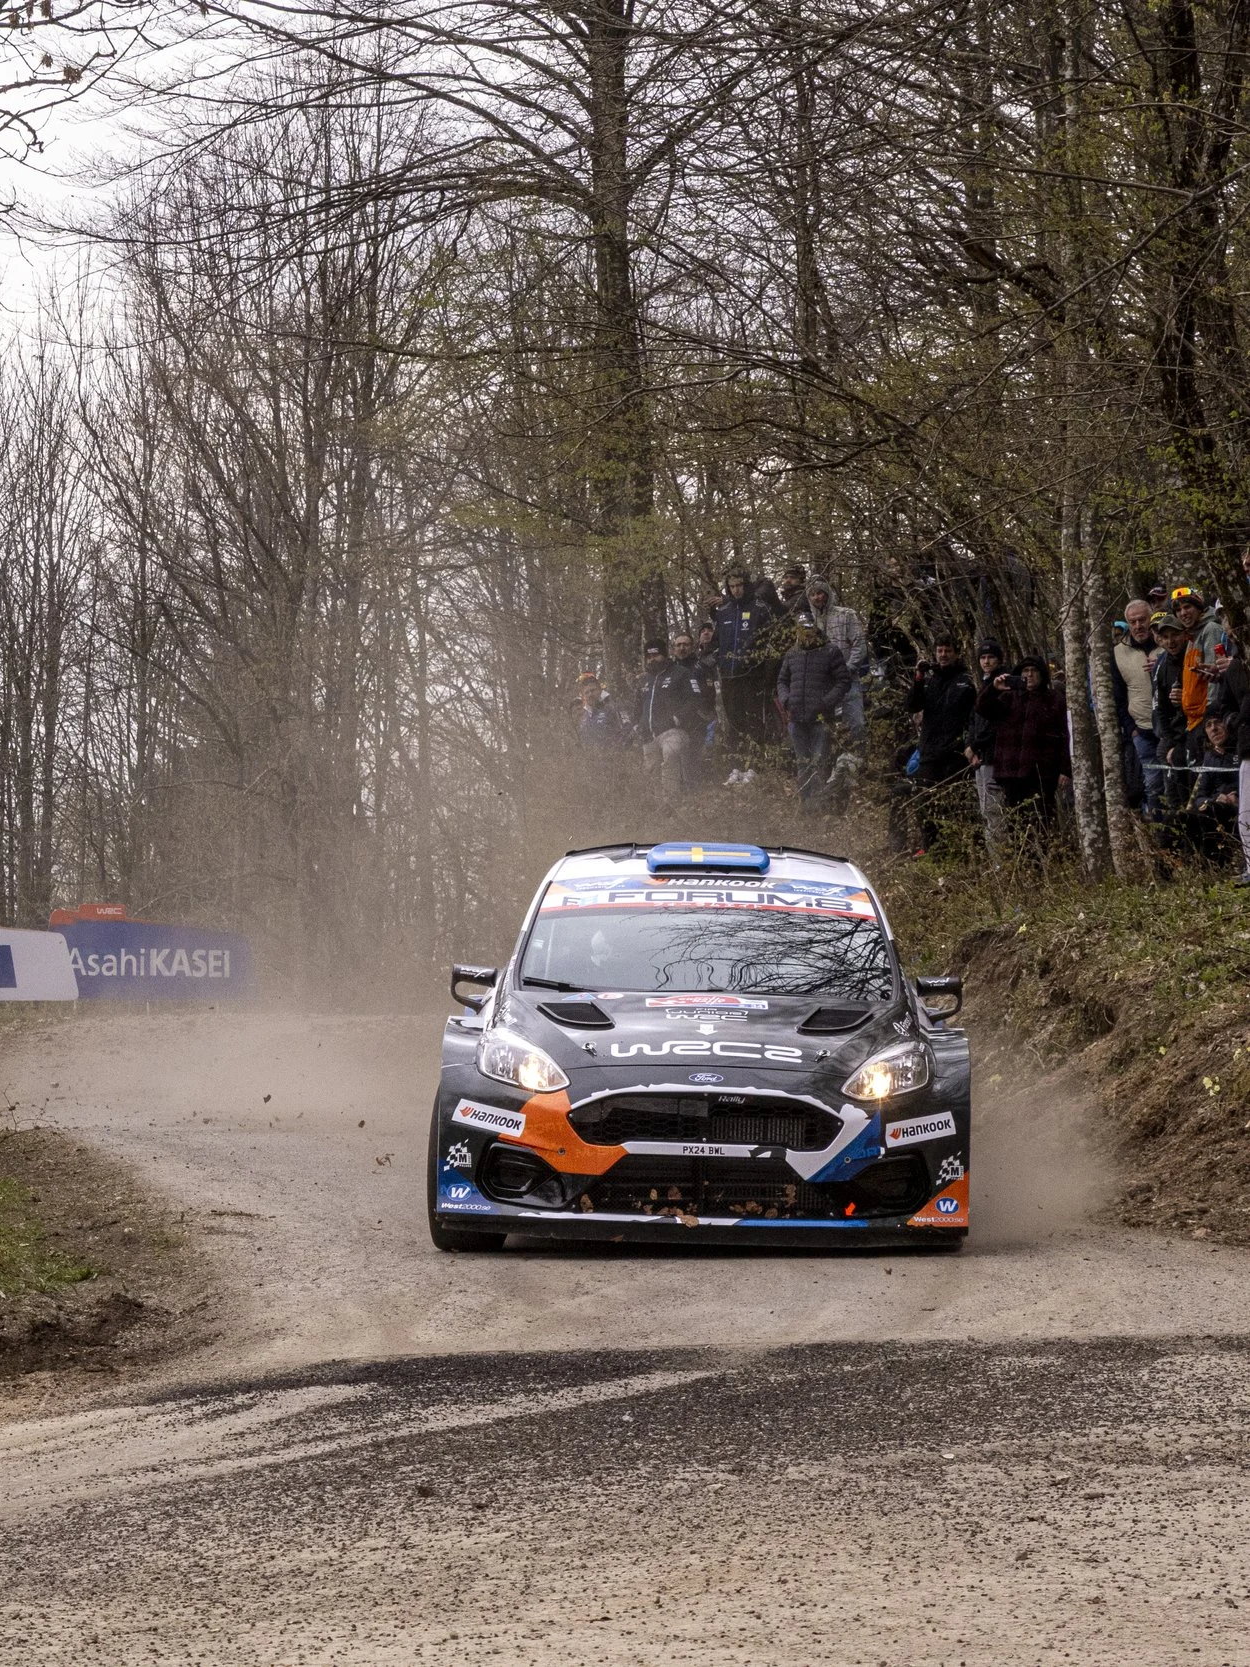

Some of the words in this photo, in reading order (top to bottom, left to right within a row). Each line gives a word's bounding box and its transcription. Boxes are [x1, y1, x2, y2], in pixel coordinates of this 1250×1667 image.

[608, 890, 853, 912] FORUM8
[96, 907, 123, 915] WRC
[611, 1040, 803, 1063] WRC2
[695, 1073, 718, 1082] Ford
[718, 1095, 746, 1105] Rally
[682, 1146, 705, 1154] PX24
[708, 1147, 725, 1155] BWL
[451, 1187, 470, 1198] W
[939, 1200, 957, 1212] W
